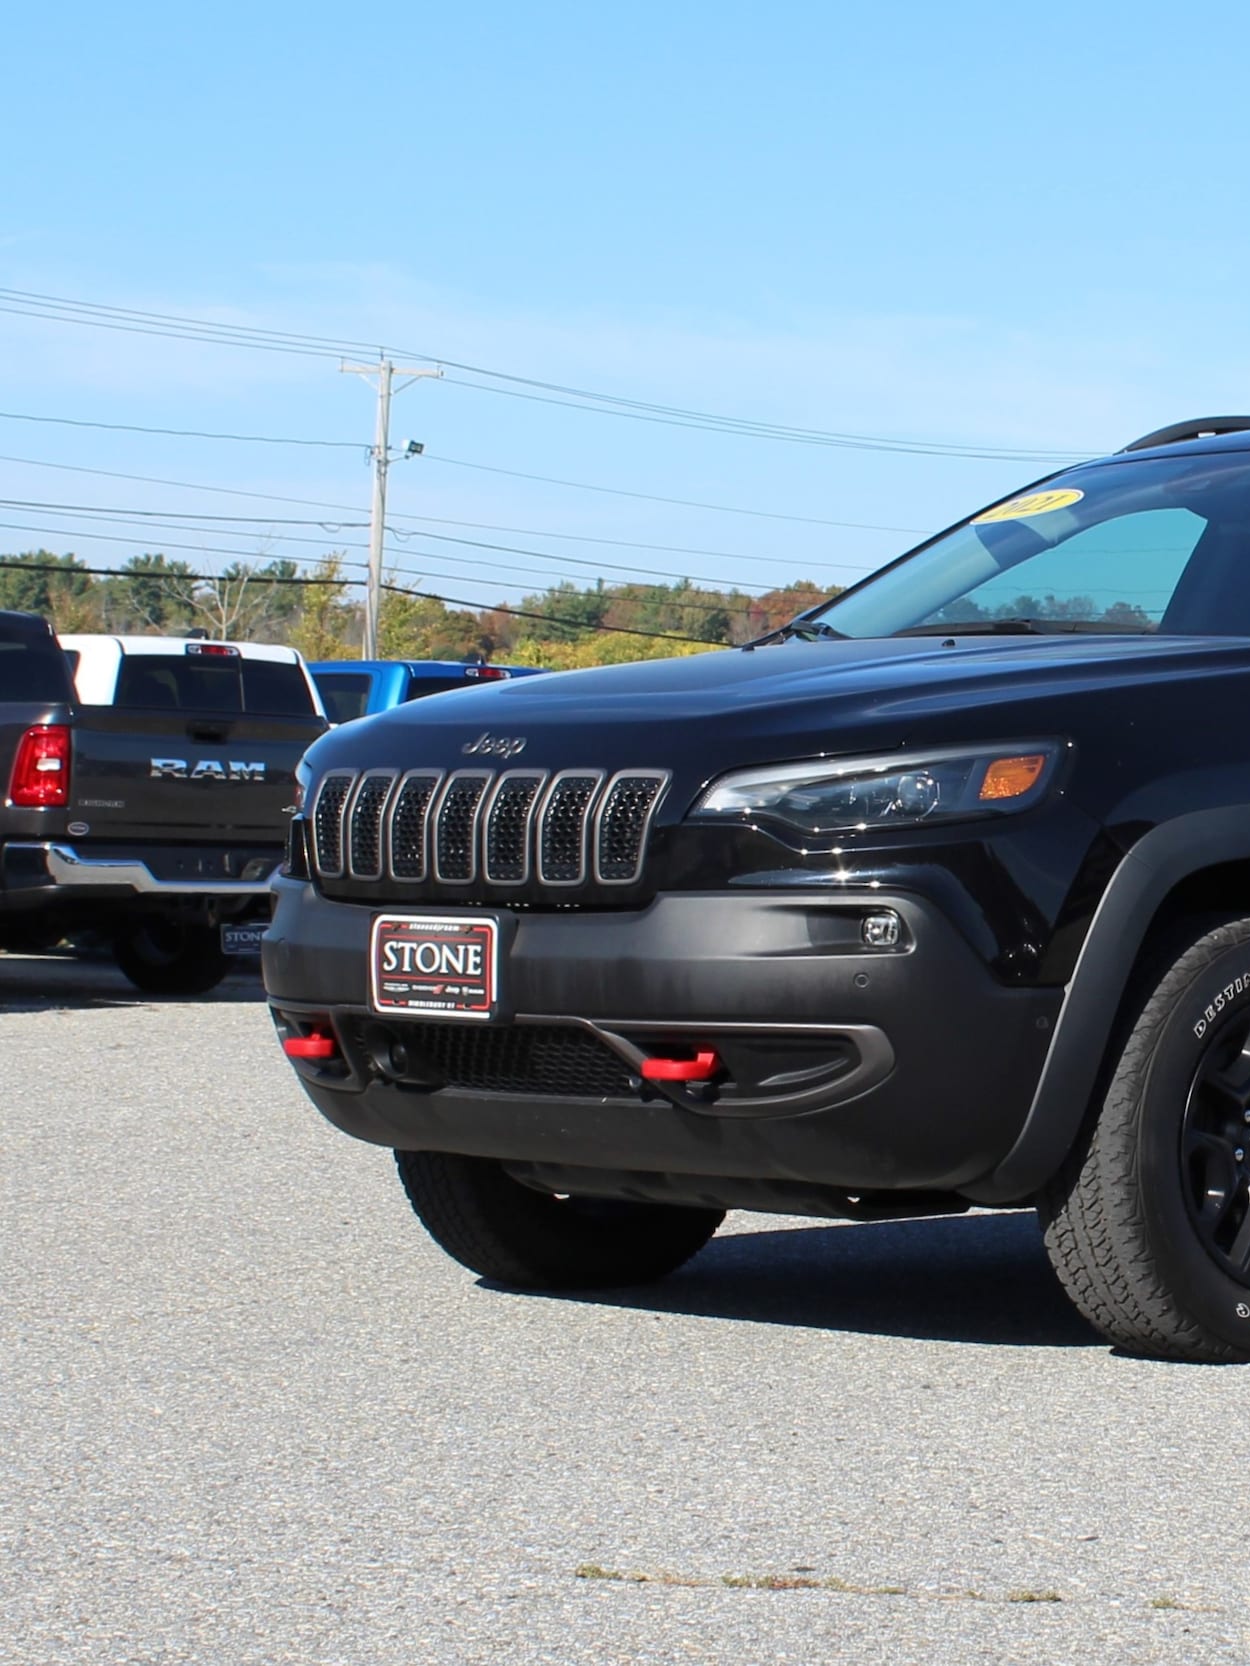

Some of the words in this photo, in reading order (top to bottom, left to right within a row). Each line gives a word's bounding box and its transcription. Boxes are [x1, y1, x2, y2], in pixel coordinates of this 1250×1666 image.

[461, 731, 527, 759] Jeep
[150, 757, 265, 781] RAM
[225, 931, 261, 942] STON
[383, 941, 482, 975] STONE
